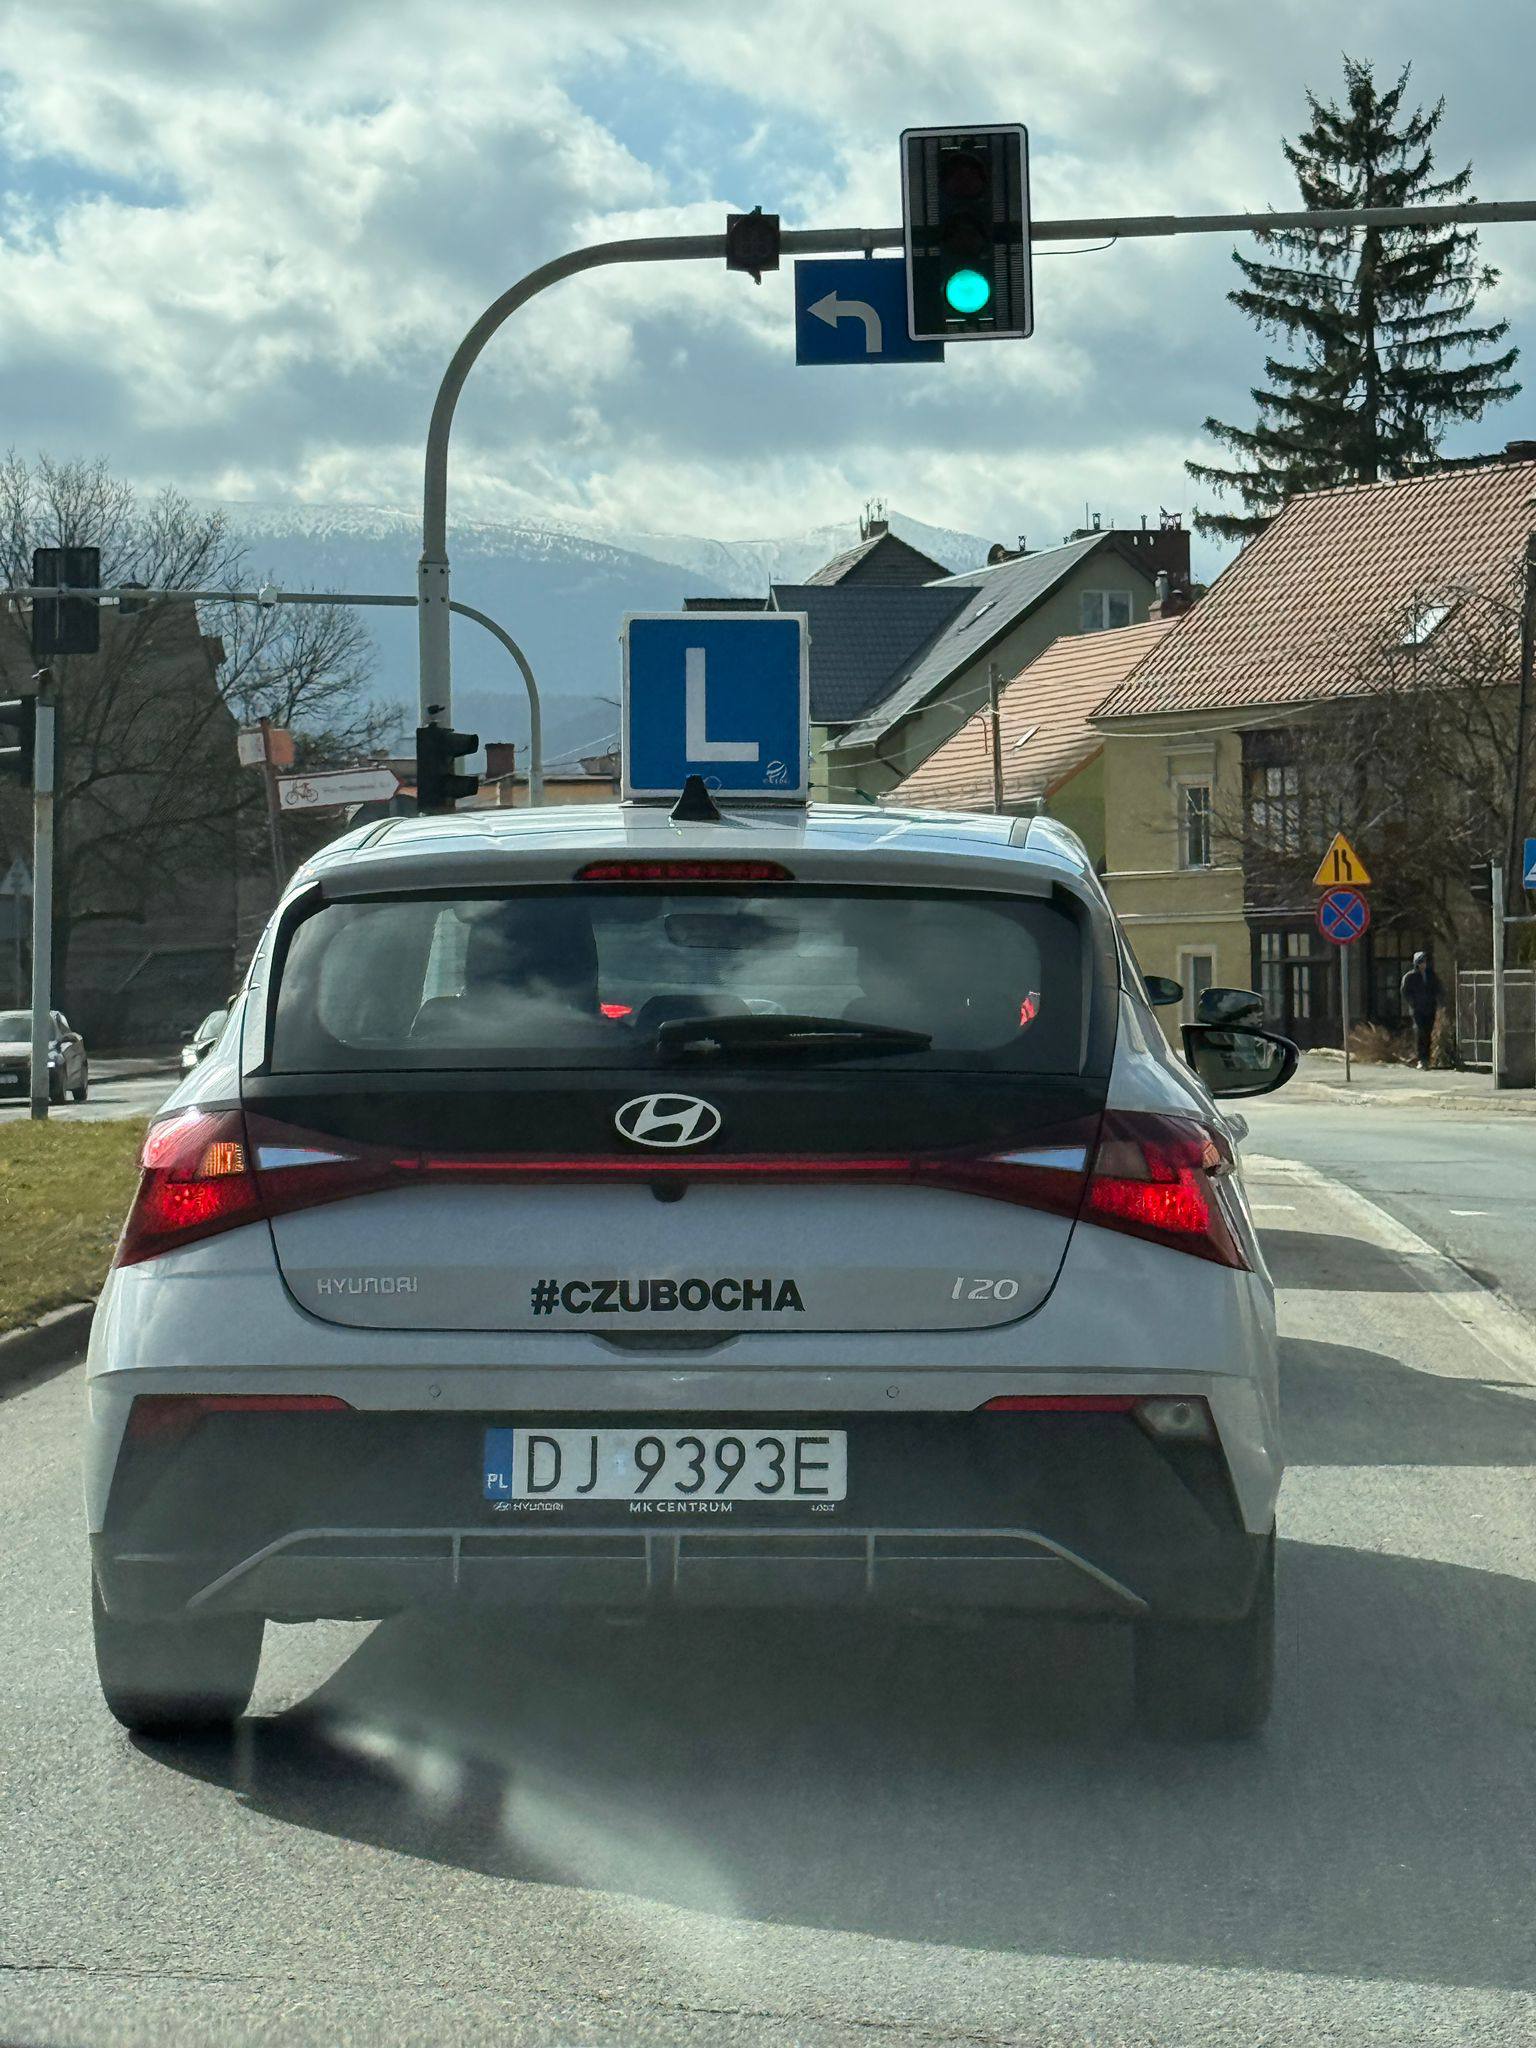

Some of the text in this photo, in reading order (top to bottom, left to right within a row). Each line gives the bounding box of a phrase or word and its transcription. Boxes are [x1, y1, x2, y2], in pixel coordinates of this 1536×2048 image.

[686, 647, 759, 762] L
[317, 1276, 418, 1294] HYUNDAI
[531, 1278, 806, 1315] #CZUBOCHA
[526, 1435, 830, 1496] DJ 9393E
[488, 1473, 508, 1489] PL
[629, 1502, 733, 1512] MK CENTRUM
